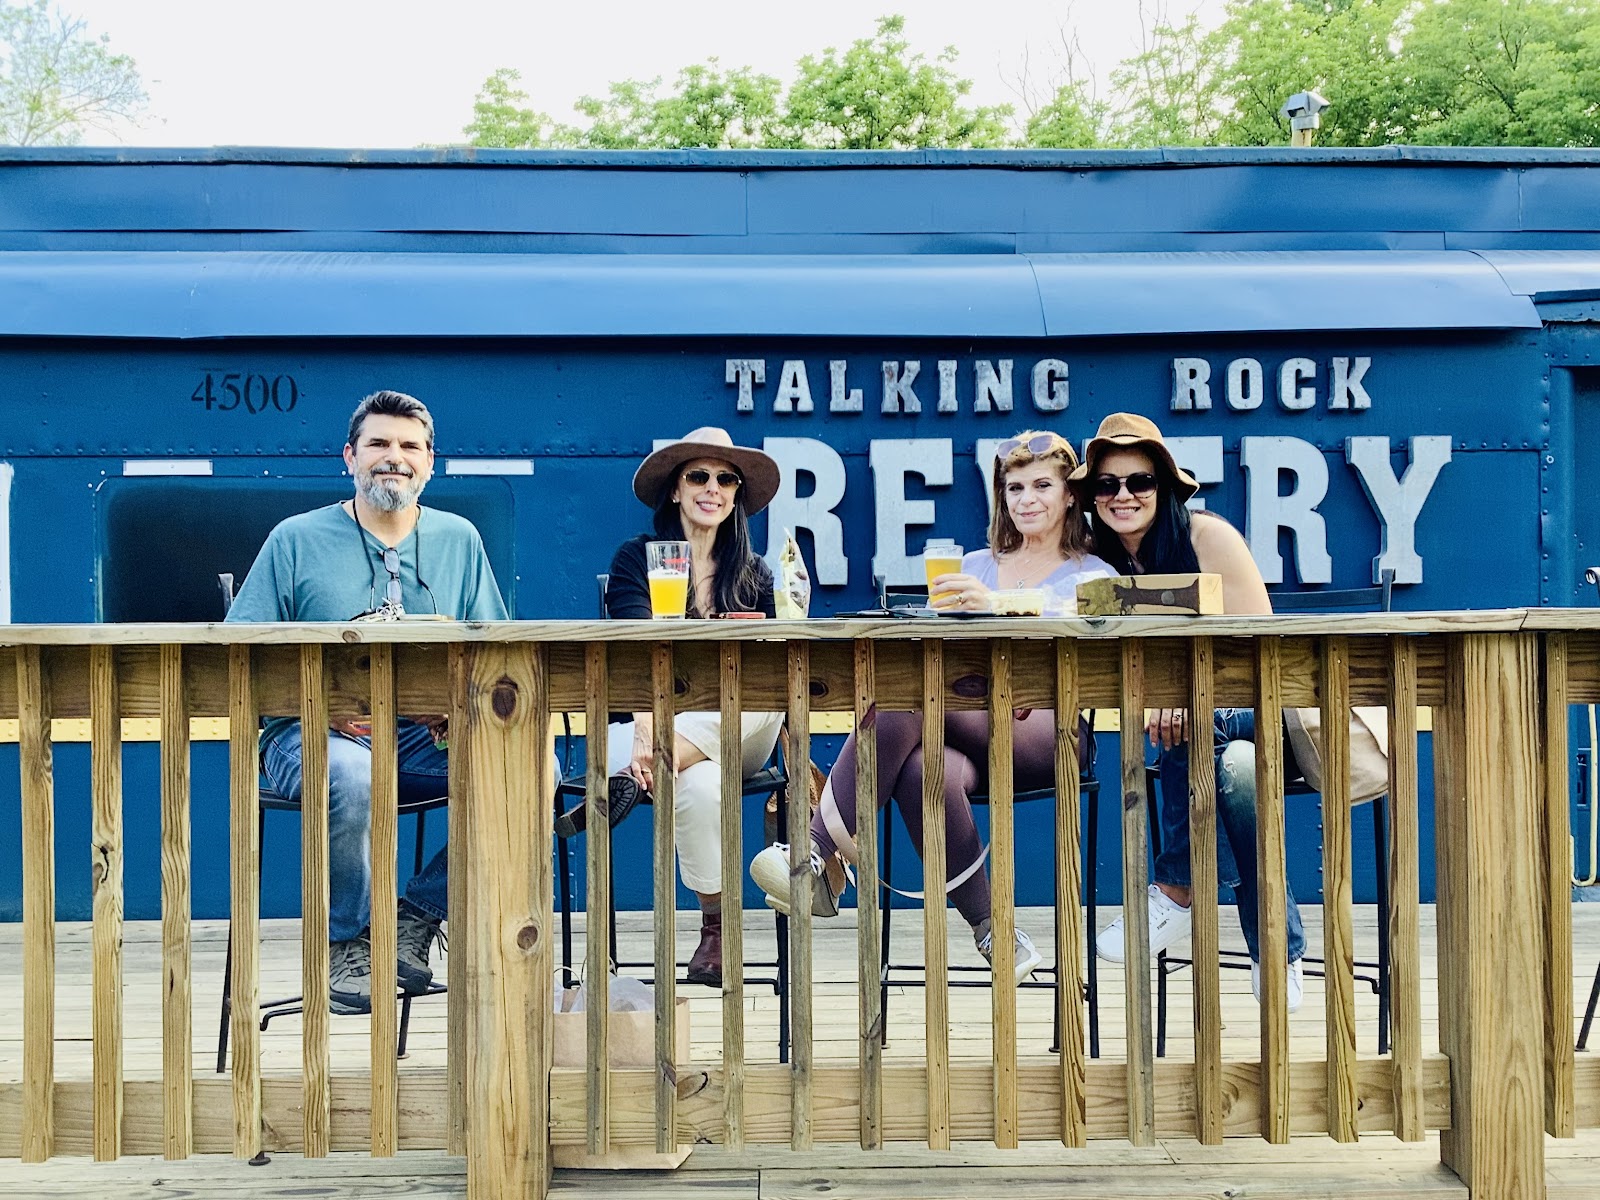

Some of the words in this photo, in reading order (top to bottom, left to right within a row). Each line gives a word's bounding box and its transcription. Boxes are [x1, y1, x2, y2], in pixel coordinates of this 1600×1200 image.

[191, 373, 298, 414] 4500
[725, 358, 1070, 412] TALKING
[1170, 357, 1372, 411] ROCK
[652, 435, 1453, 586] RERY
